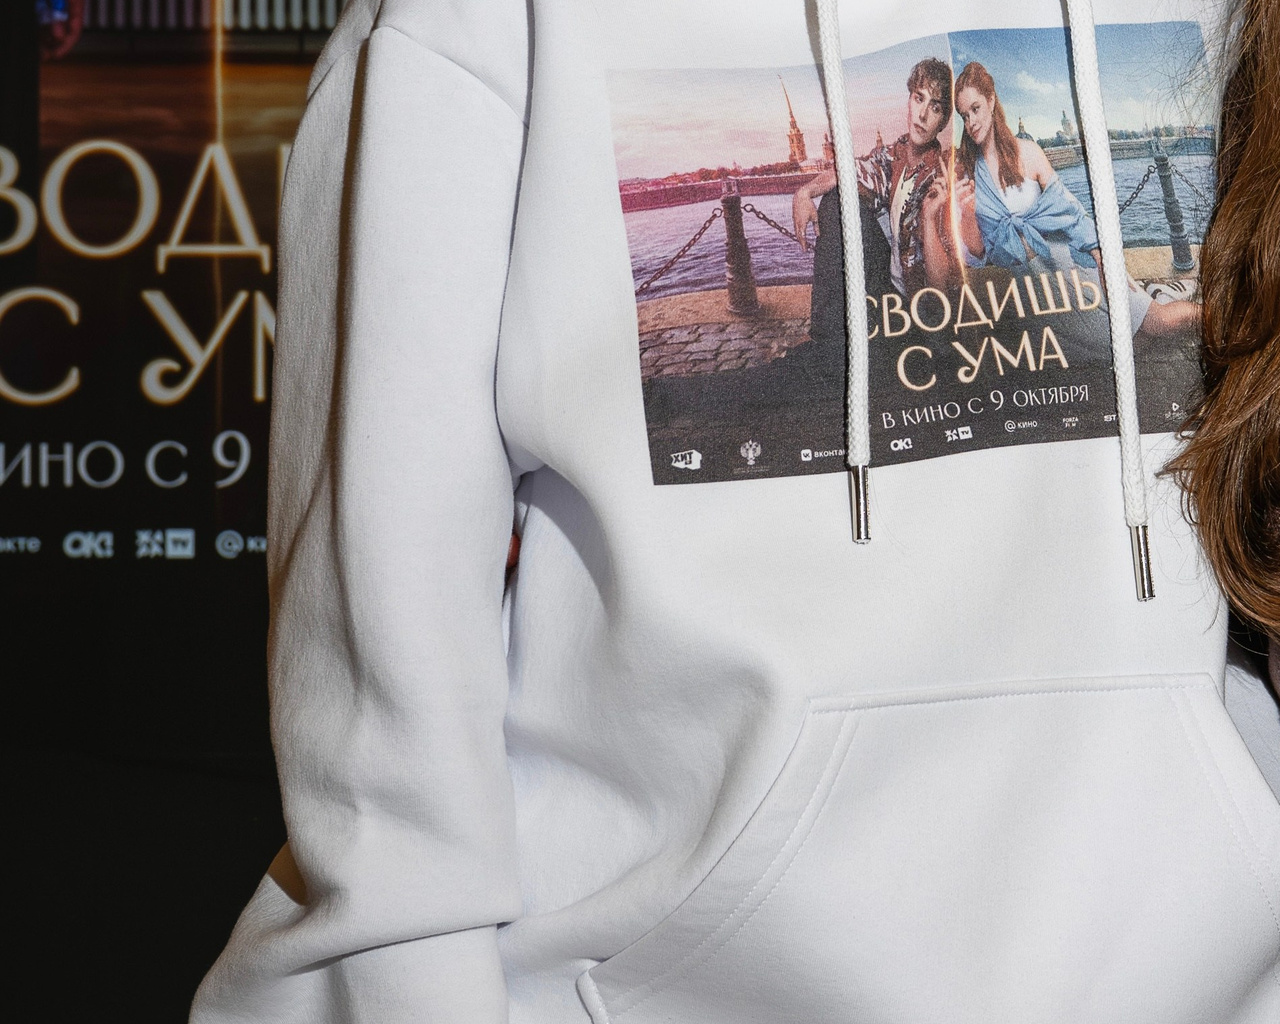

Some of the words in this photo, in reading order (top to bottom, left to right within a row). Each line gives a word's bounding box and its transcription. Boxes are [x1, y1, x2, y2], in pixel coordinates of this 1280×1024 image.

[0, 140, 290, 273] ОД
[141, 290, 276, 405] У
[896, 345, 937, 391] С
[952, 326, 1069, 384] УМА
[882, 412, 895, 429] В
[902, 402, 961, 426] КИНО
[967, 397, 984, 414] С
[990, 390, 1004, 411] 9
[1013, 385, 1089, 407] ОКТЯБРЯ
[145, 440, 188, 488] С
[212, 430, 251, 488] 9
[674, 452, 693, 463] ХИТ
[814, 449, 845, 458] вконта
